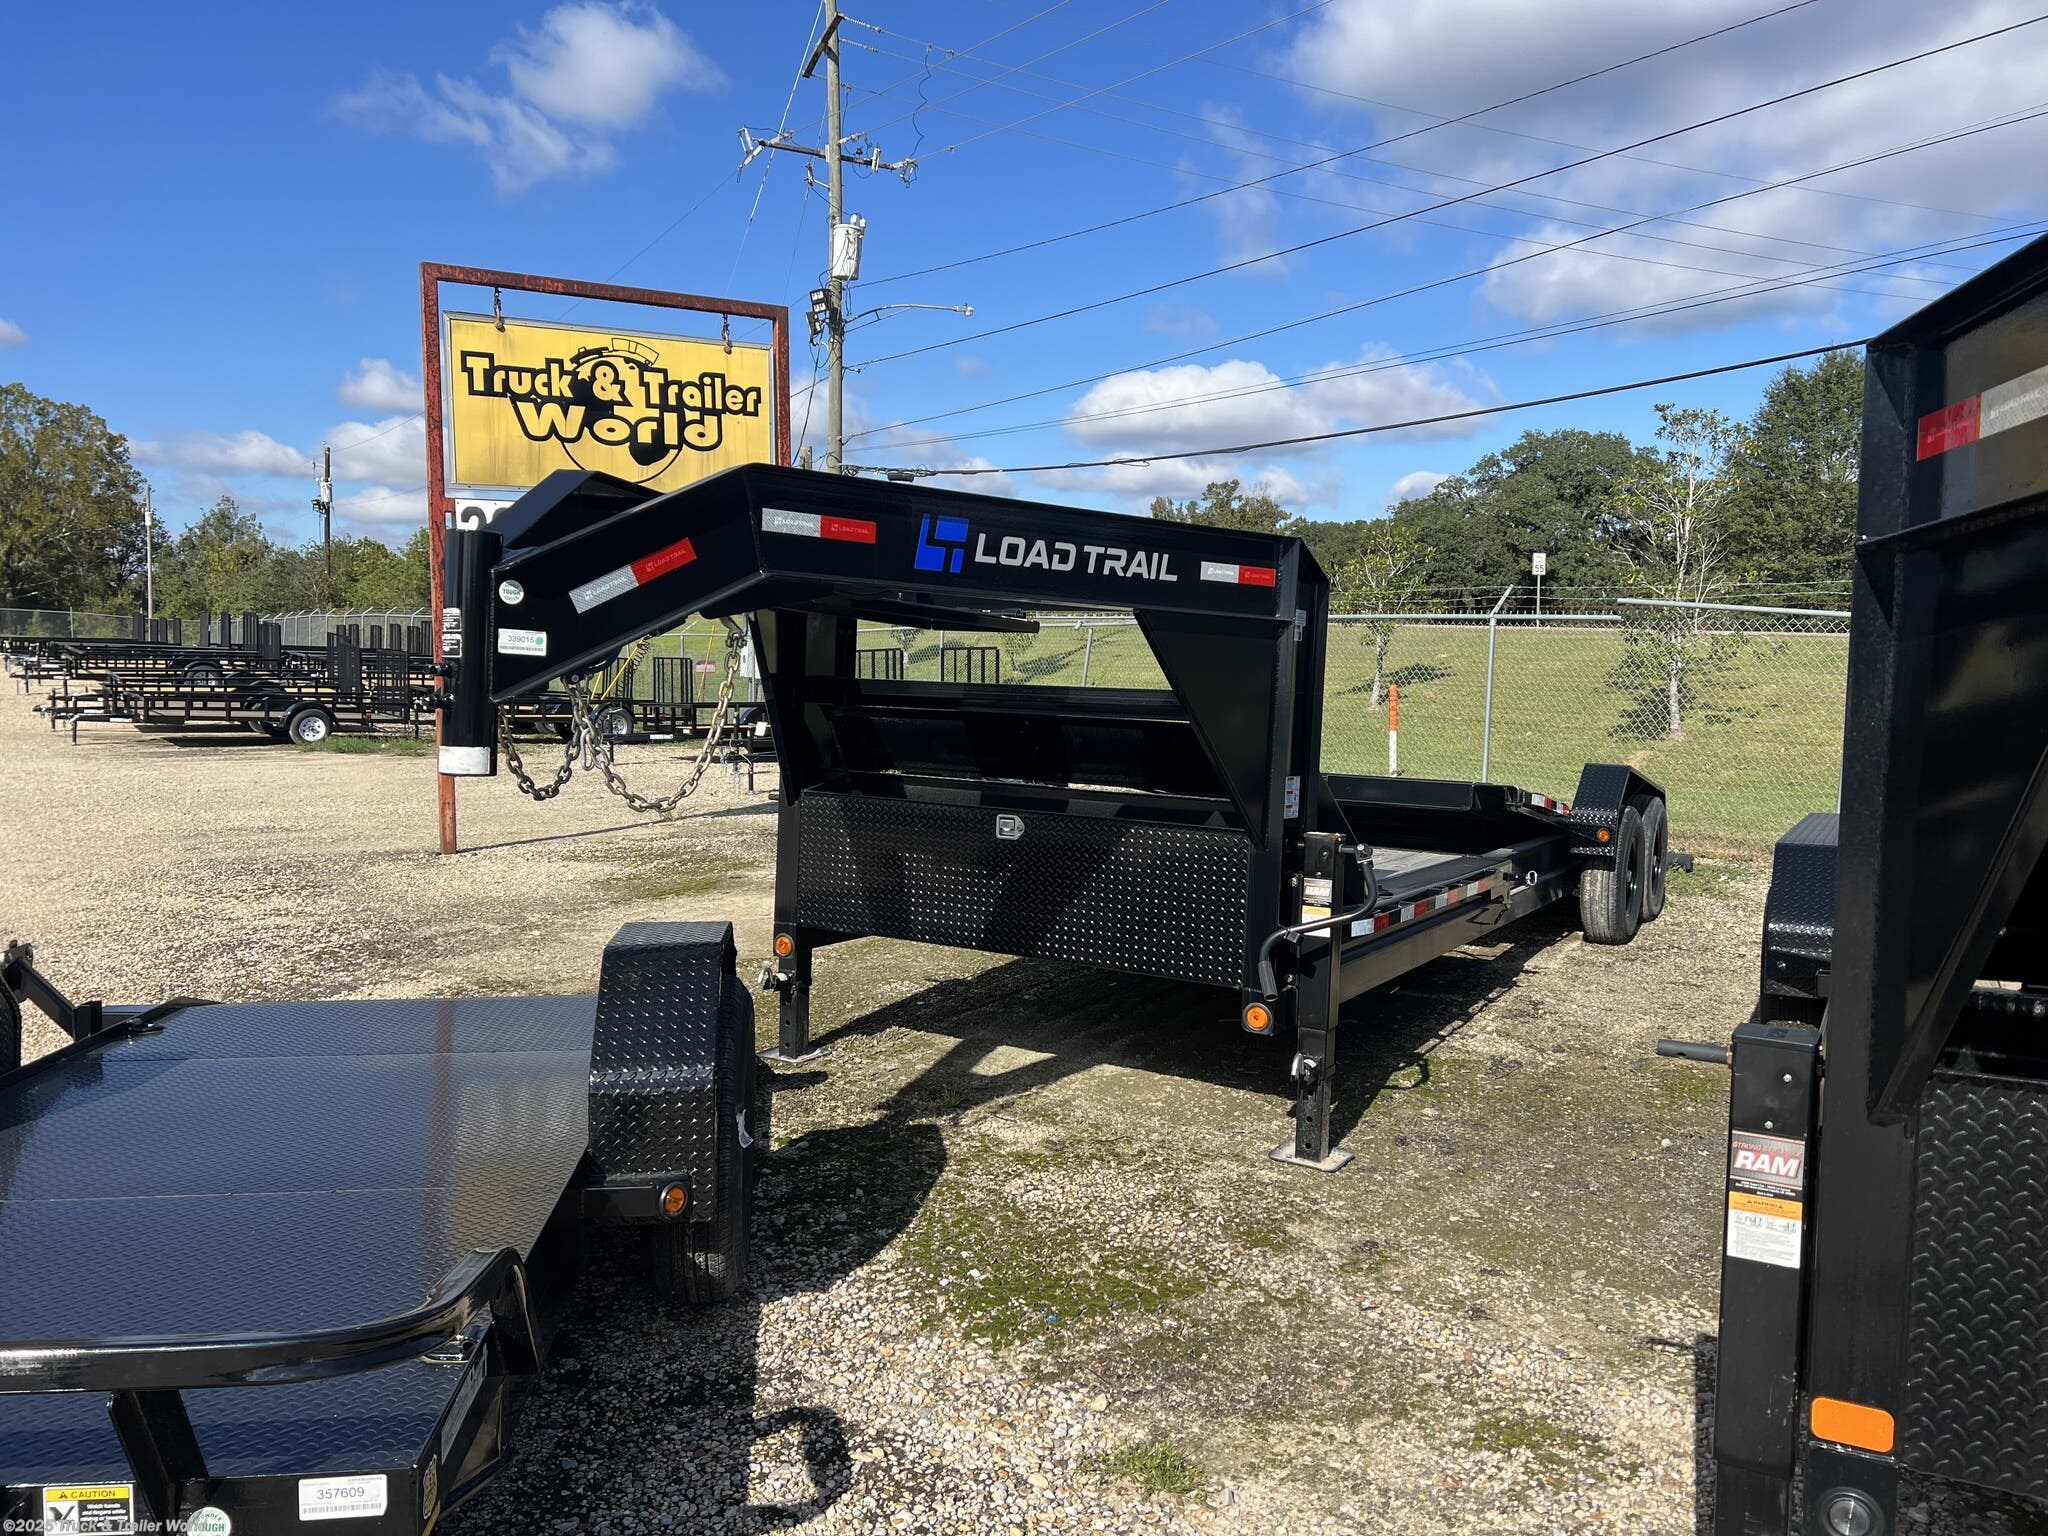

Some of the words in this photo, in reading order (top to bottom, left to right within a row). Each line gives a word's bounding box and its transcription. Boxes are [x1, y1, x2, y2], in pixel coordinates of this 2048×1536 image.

[461, 350, 575, 399] Truck
[591, 361, 625, 403] &
[639, 366, 761, 416] Trailer
[510, 396, 722, 451] World
[653, 555, 670, 567] LOAD
[670, 549, 687, 560] TRAIL
[975, 533, 1077, 571] LOAD
[1083, 545, 1178, 582] TRAIL
[592, 584, 609, 595] LOAD
[507, 634, 535, 644] 339015
[1305, 886, 1330, 897] RAM
[1734, 1151, 1800, 1177] RAM
[71, 1490, 116, 1499] CAUTION
[316, 1486, 365, 1500] 357609
